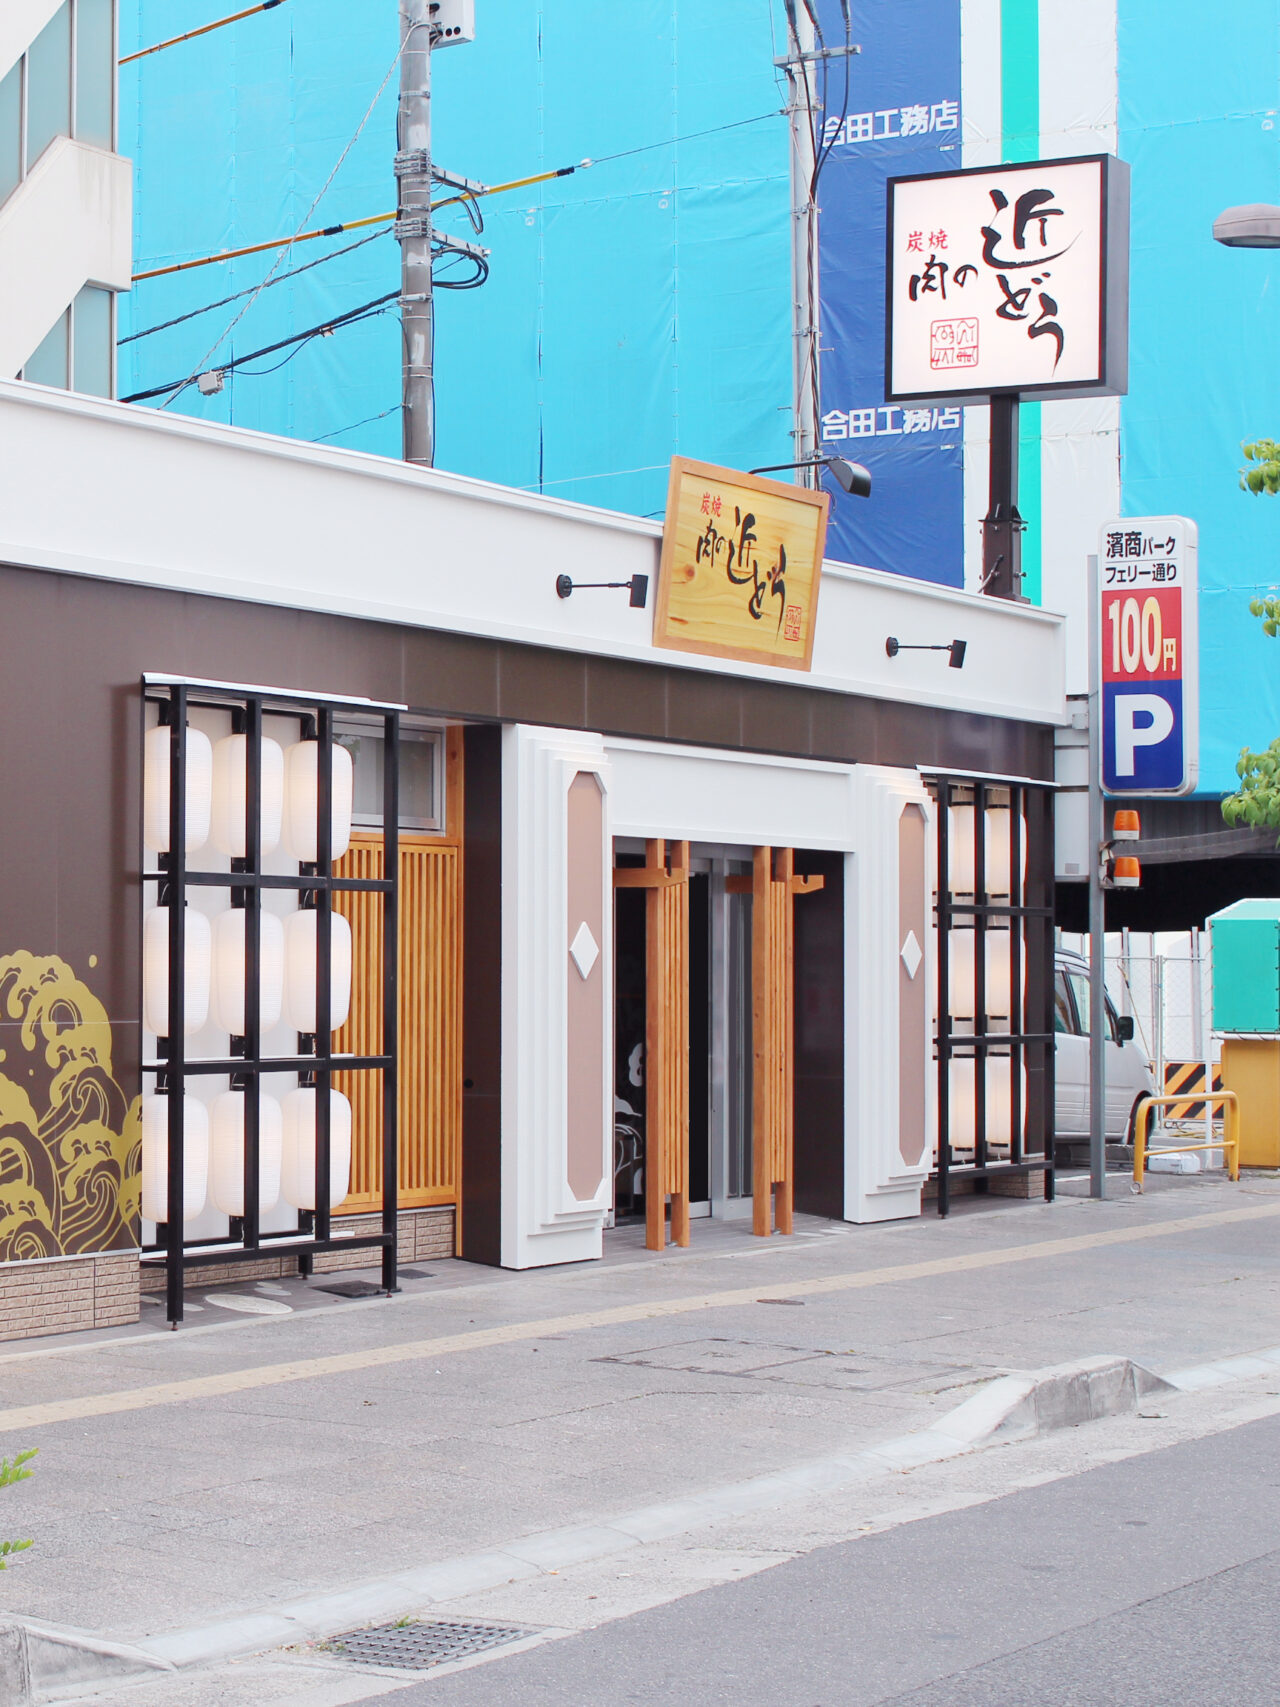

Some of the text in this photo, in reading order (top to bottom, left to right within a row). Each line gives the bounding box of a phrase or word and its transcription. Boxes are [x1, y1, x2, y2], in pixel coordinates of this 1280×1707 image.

[820, 100, 959, 147] 合田工務店
[906, 229, 949, 252] 炭焼
[909, 255, 978, 301] 肉の
[981, 189, 1084, 377] 近どう
[821, 406, 961, 440] 合田工務店
[700, 492, 722, 517] 炭焼
[696, 519, 726, 568] 肉の
[1106, 531, 1176, 558] 濱商パーク
[726, 506, 786, 644] 近どう
[1105, 563, 1177, 584] フェリー通り
[1109, 596, 1176, 673] 100円
[1114, 693, 1174, 776] P
